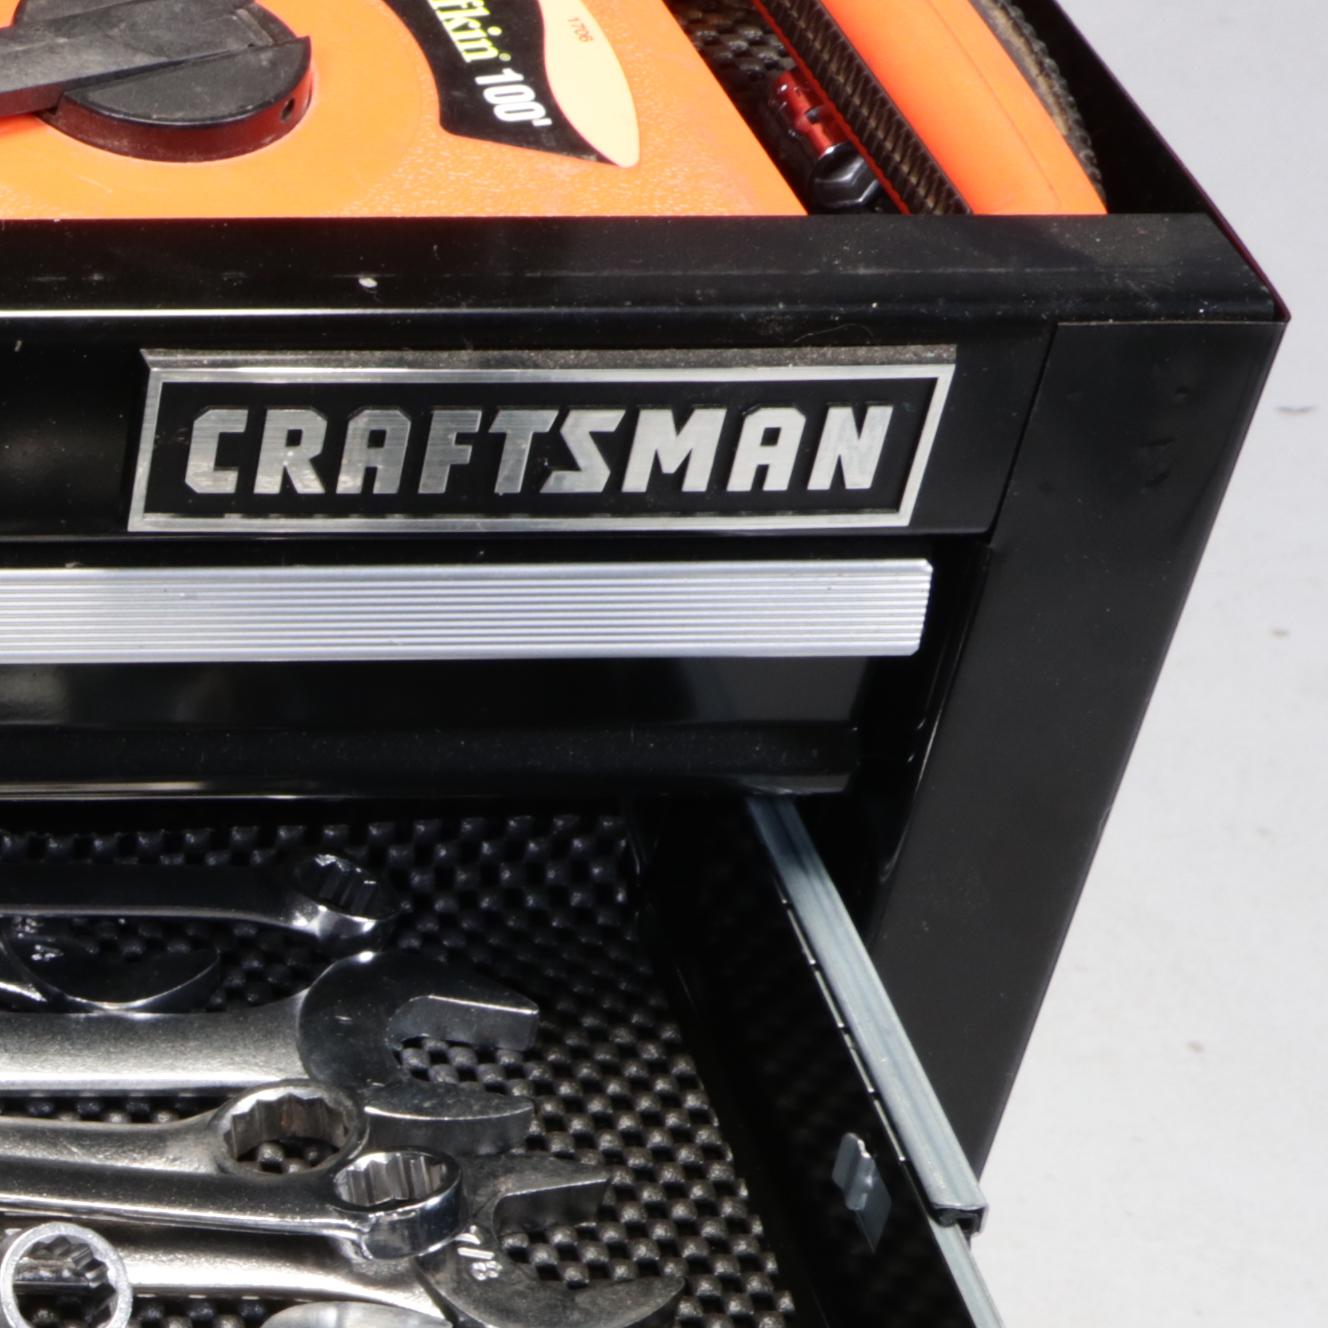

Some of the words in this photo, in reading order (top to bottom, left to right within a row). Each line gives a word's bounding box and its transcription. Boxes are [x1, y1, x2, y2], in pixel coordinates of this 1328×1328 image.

[427, 0, 502, 63] fkin
[474, 67, 553, 127] 100'
[566, 15, 595, 45] 1706
[183, 404, 896, 496] CRAFTSMAN
